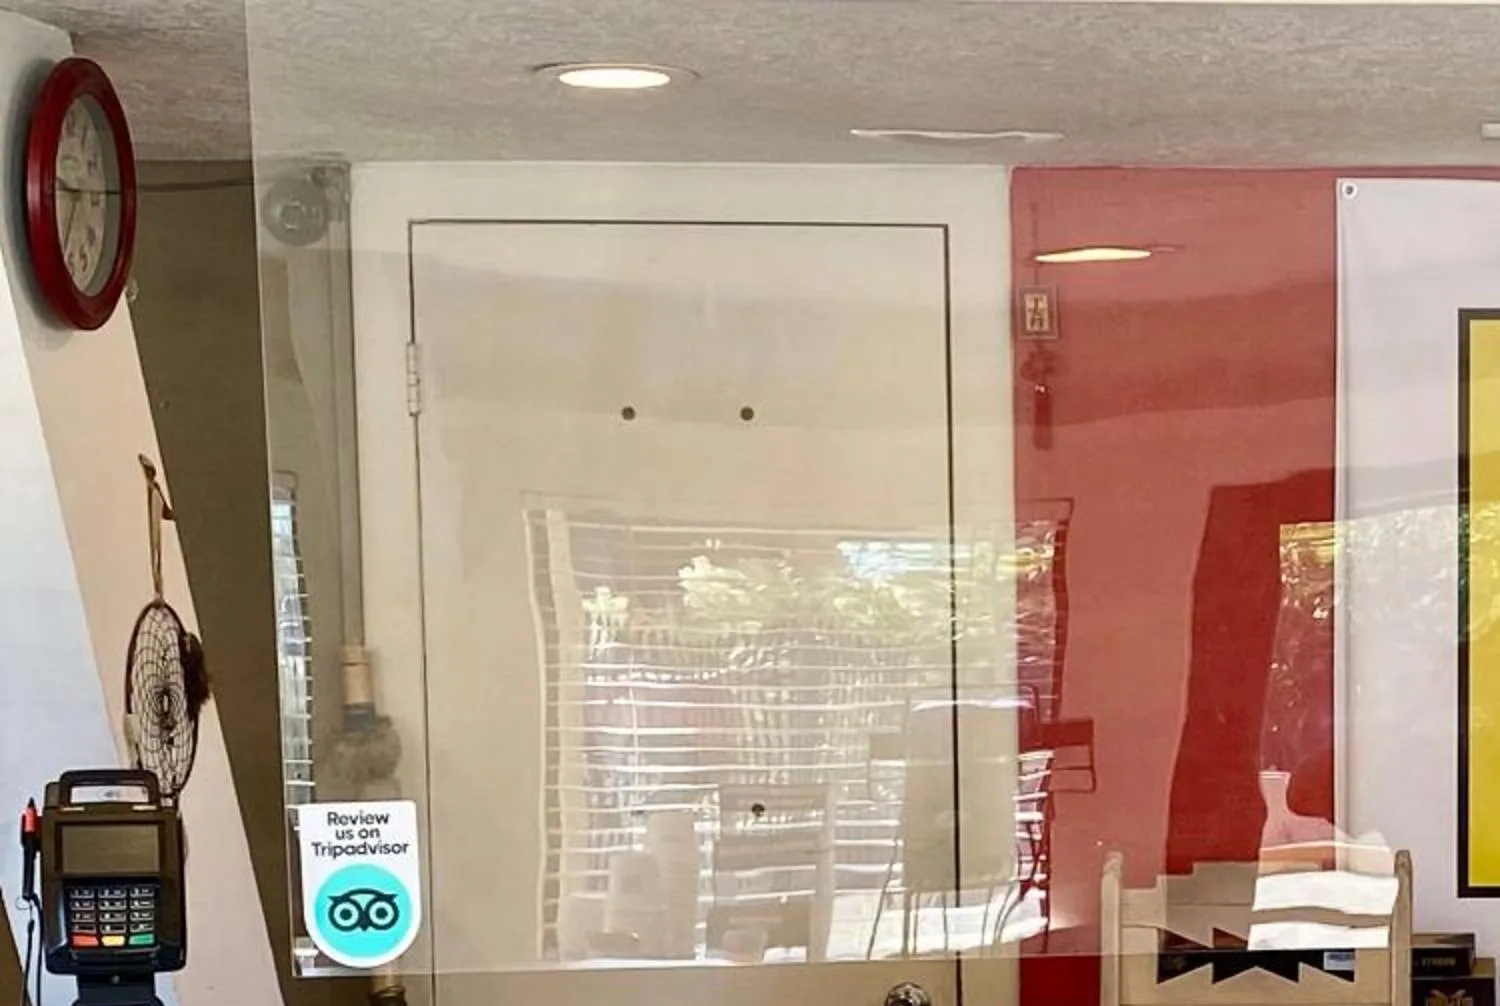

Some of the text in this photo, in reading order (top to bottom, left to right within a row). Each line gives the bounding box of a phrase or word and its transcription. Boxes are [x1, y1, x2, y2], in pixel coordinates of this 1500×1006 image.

[326, 809, 390, 826] Review
[335, 827, 381, 840] us on
[311, 840, 410, 860] Tripadvisor
